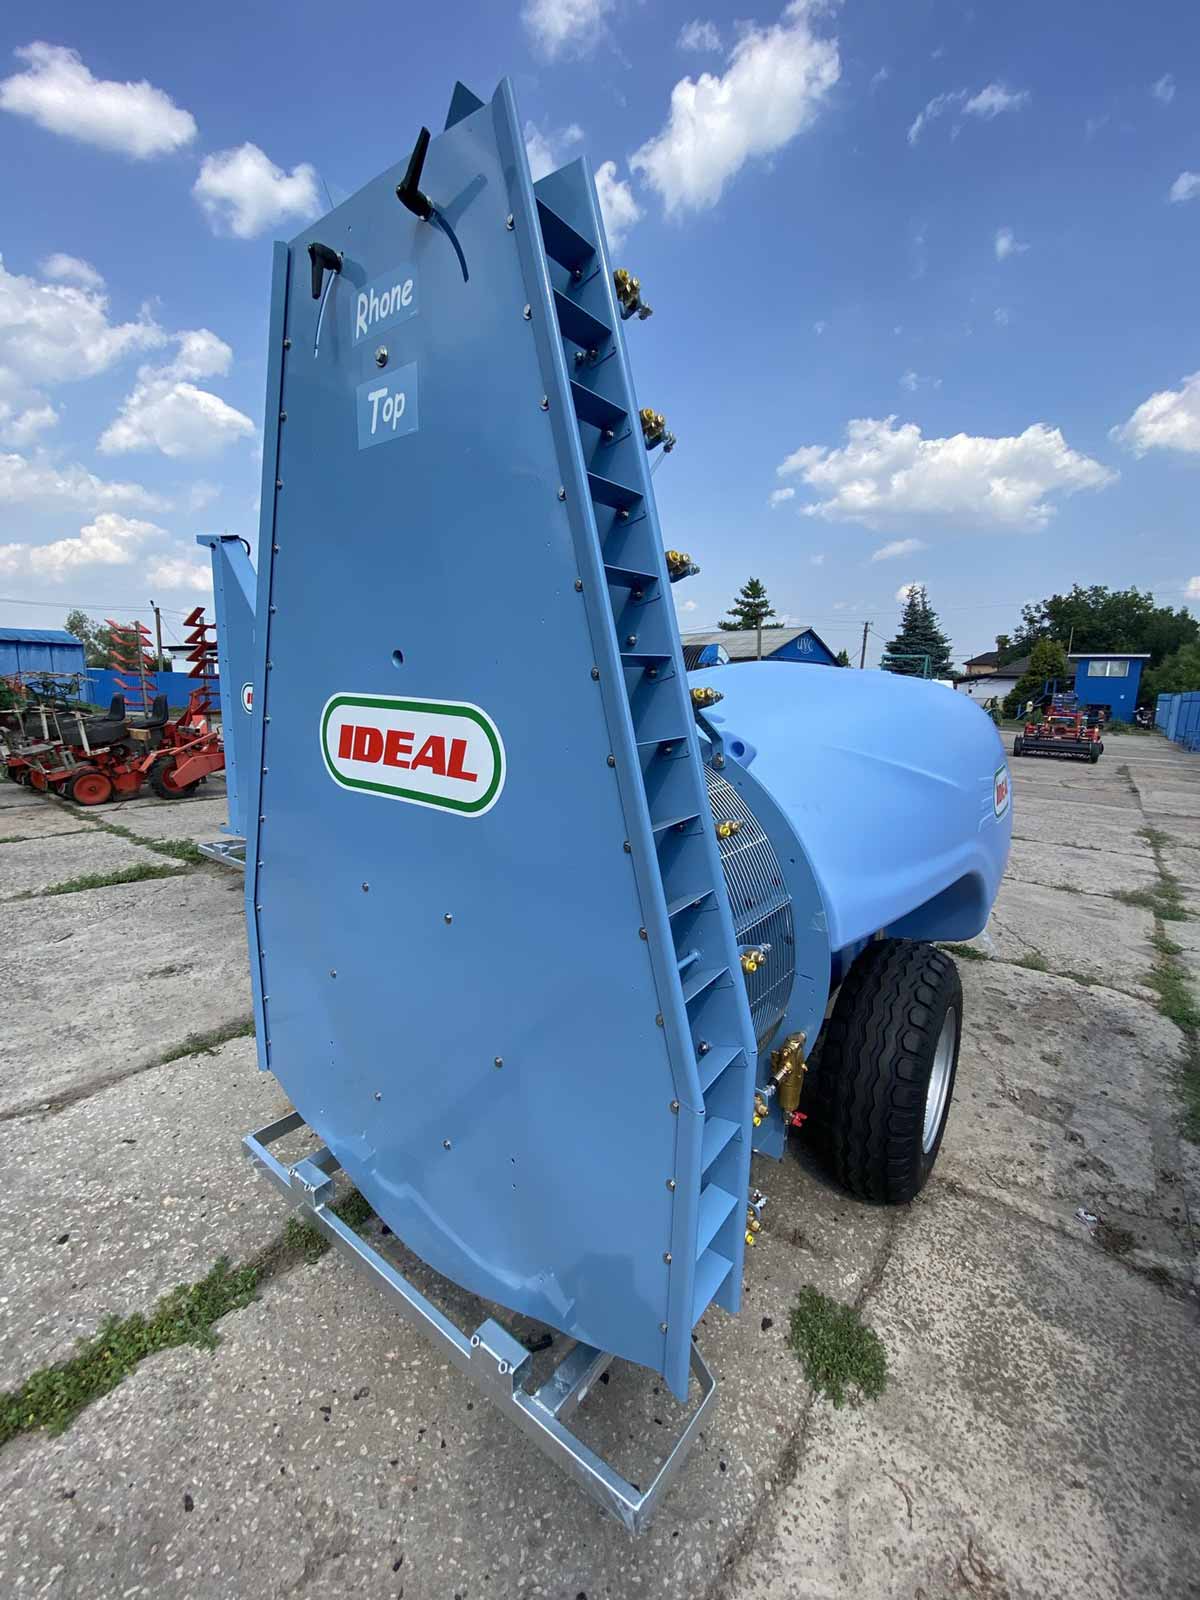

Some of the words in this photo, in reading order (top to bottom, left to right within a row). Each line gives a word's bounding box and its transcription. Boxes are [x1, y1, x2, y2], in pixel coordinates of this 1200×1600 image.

[355, 279, 414, 339] Rhone
[367, 387, 405, 434] Top
[338, 724, 478, 783] IDEAL
